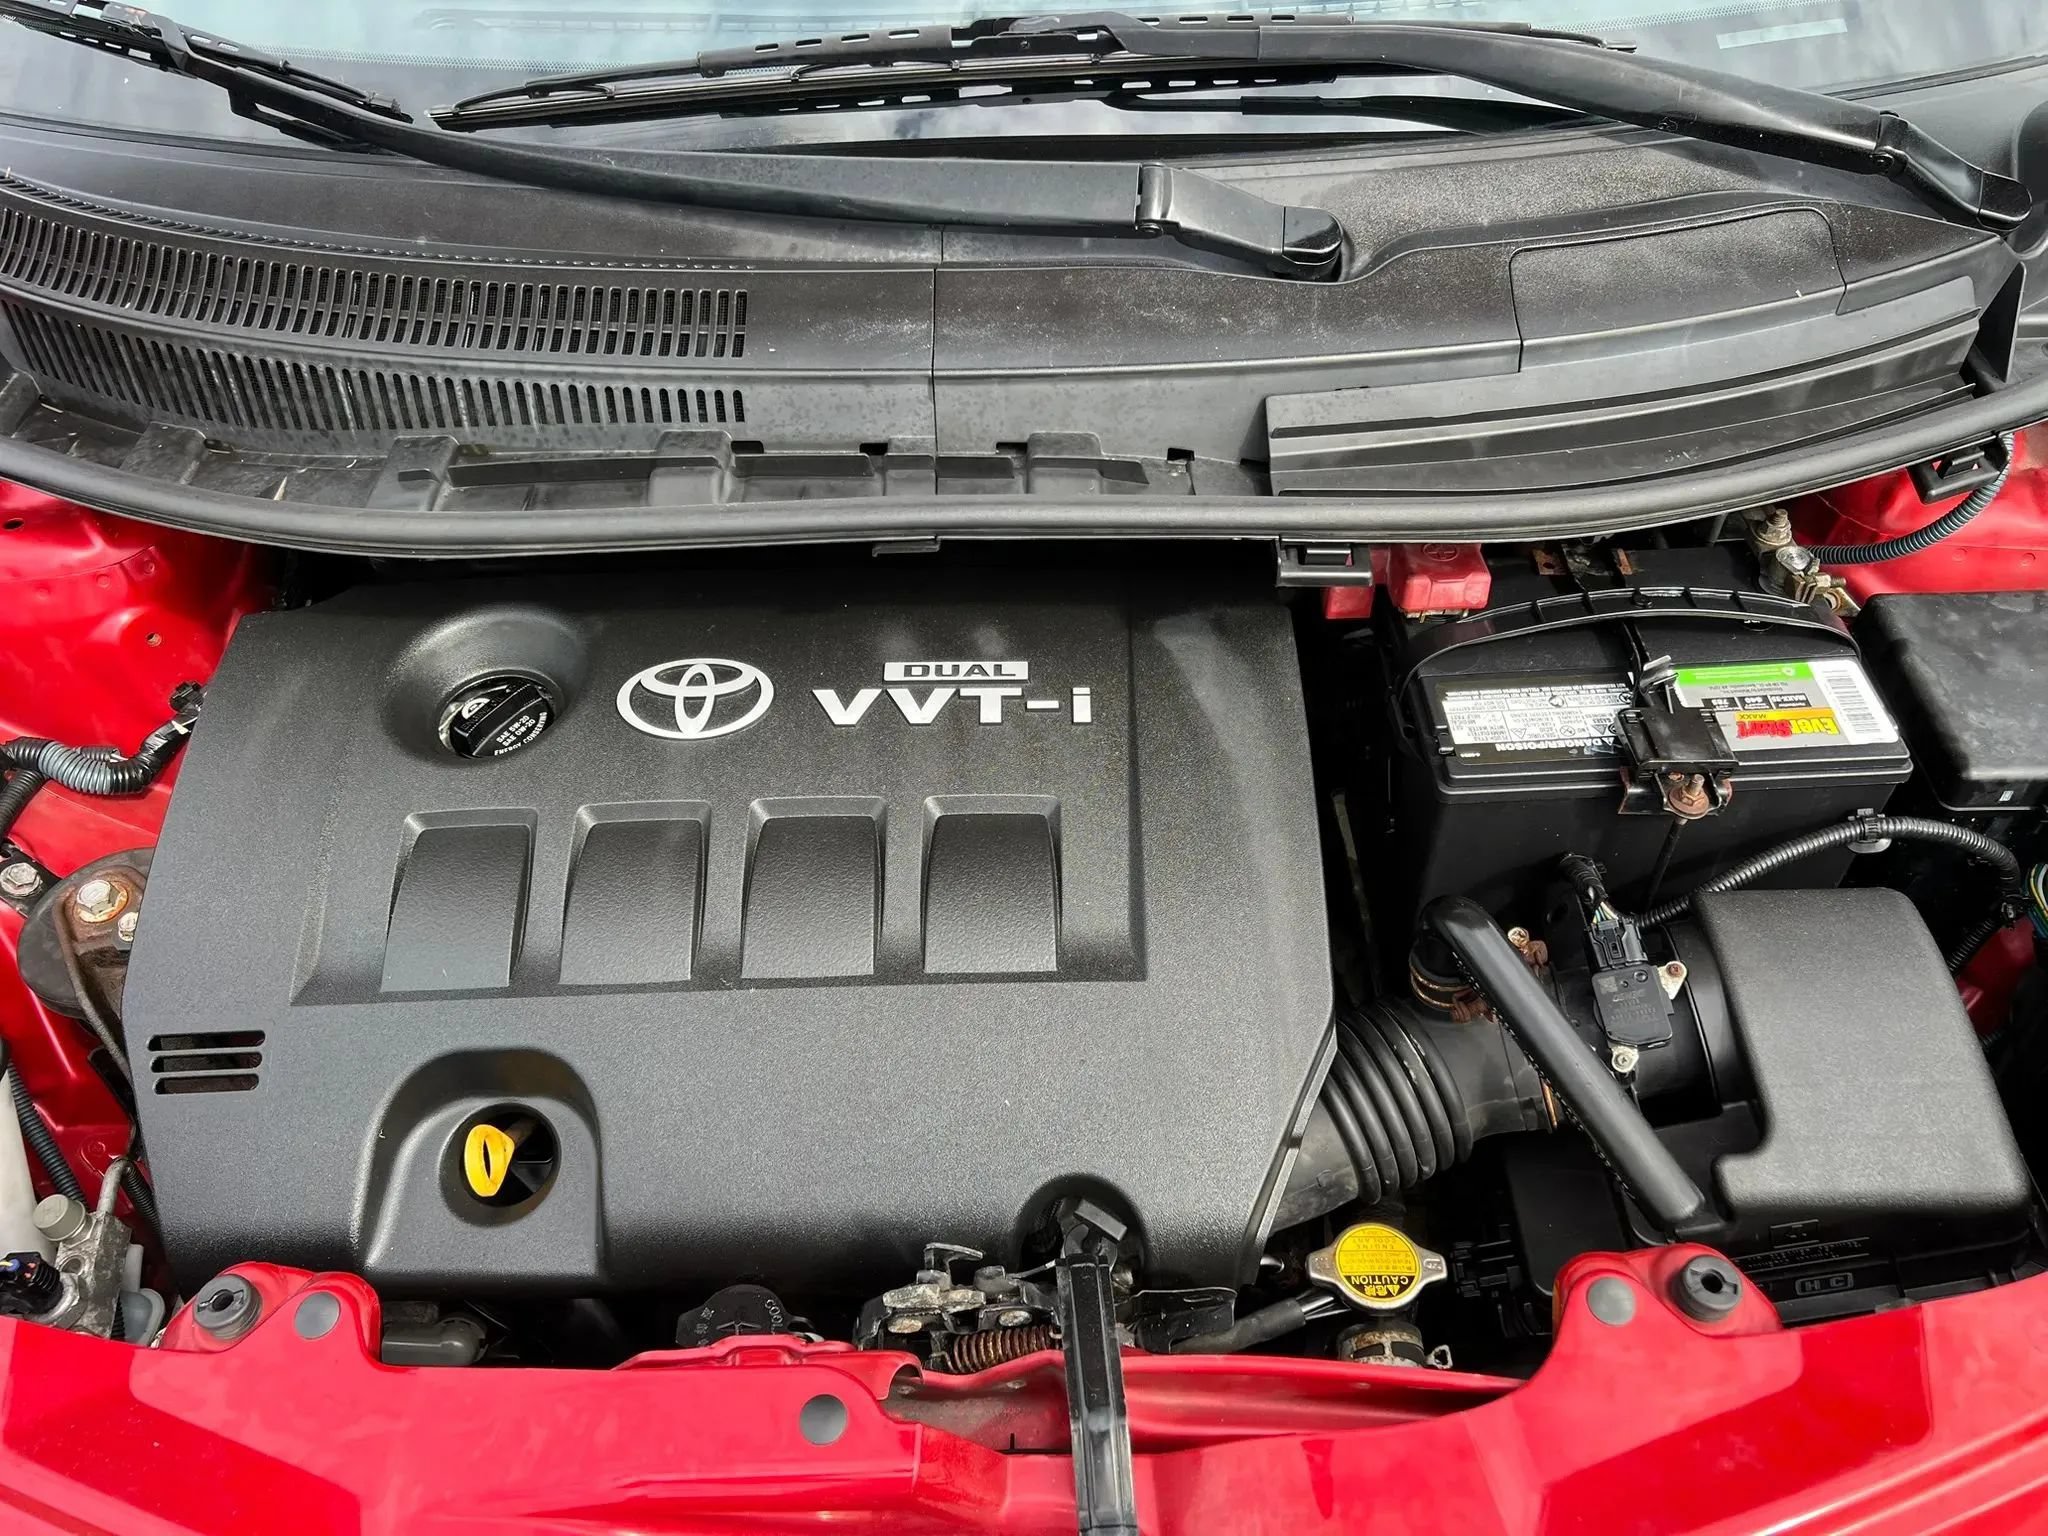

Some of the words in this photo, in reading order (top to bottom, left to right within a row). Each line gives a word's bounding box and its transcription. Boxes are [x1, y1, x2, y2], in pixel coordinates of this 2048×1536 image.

[903, 664, 1017, 678] DUAL
[812, 687, 1092, 725] VVT-i
[496, 730, 510, 744] SAE
[508, 715, 530, 732] 5W-20
[1736, 718, 1840, 739] EverStart
[502, 735, 516, 747] SAE
[1495, 738, 1602, 752] DANGER/POISON
[1351, 1276, 1409, 1284] CAUTION
